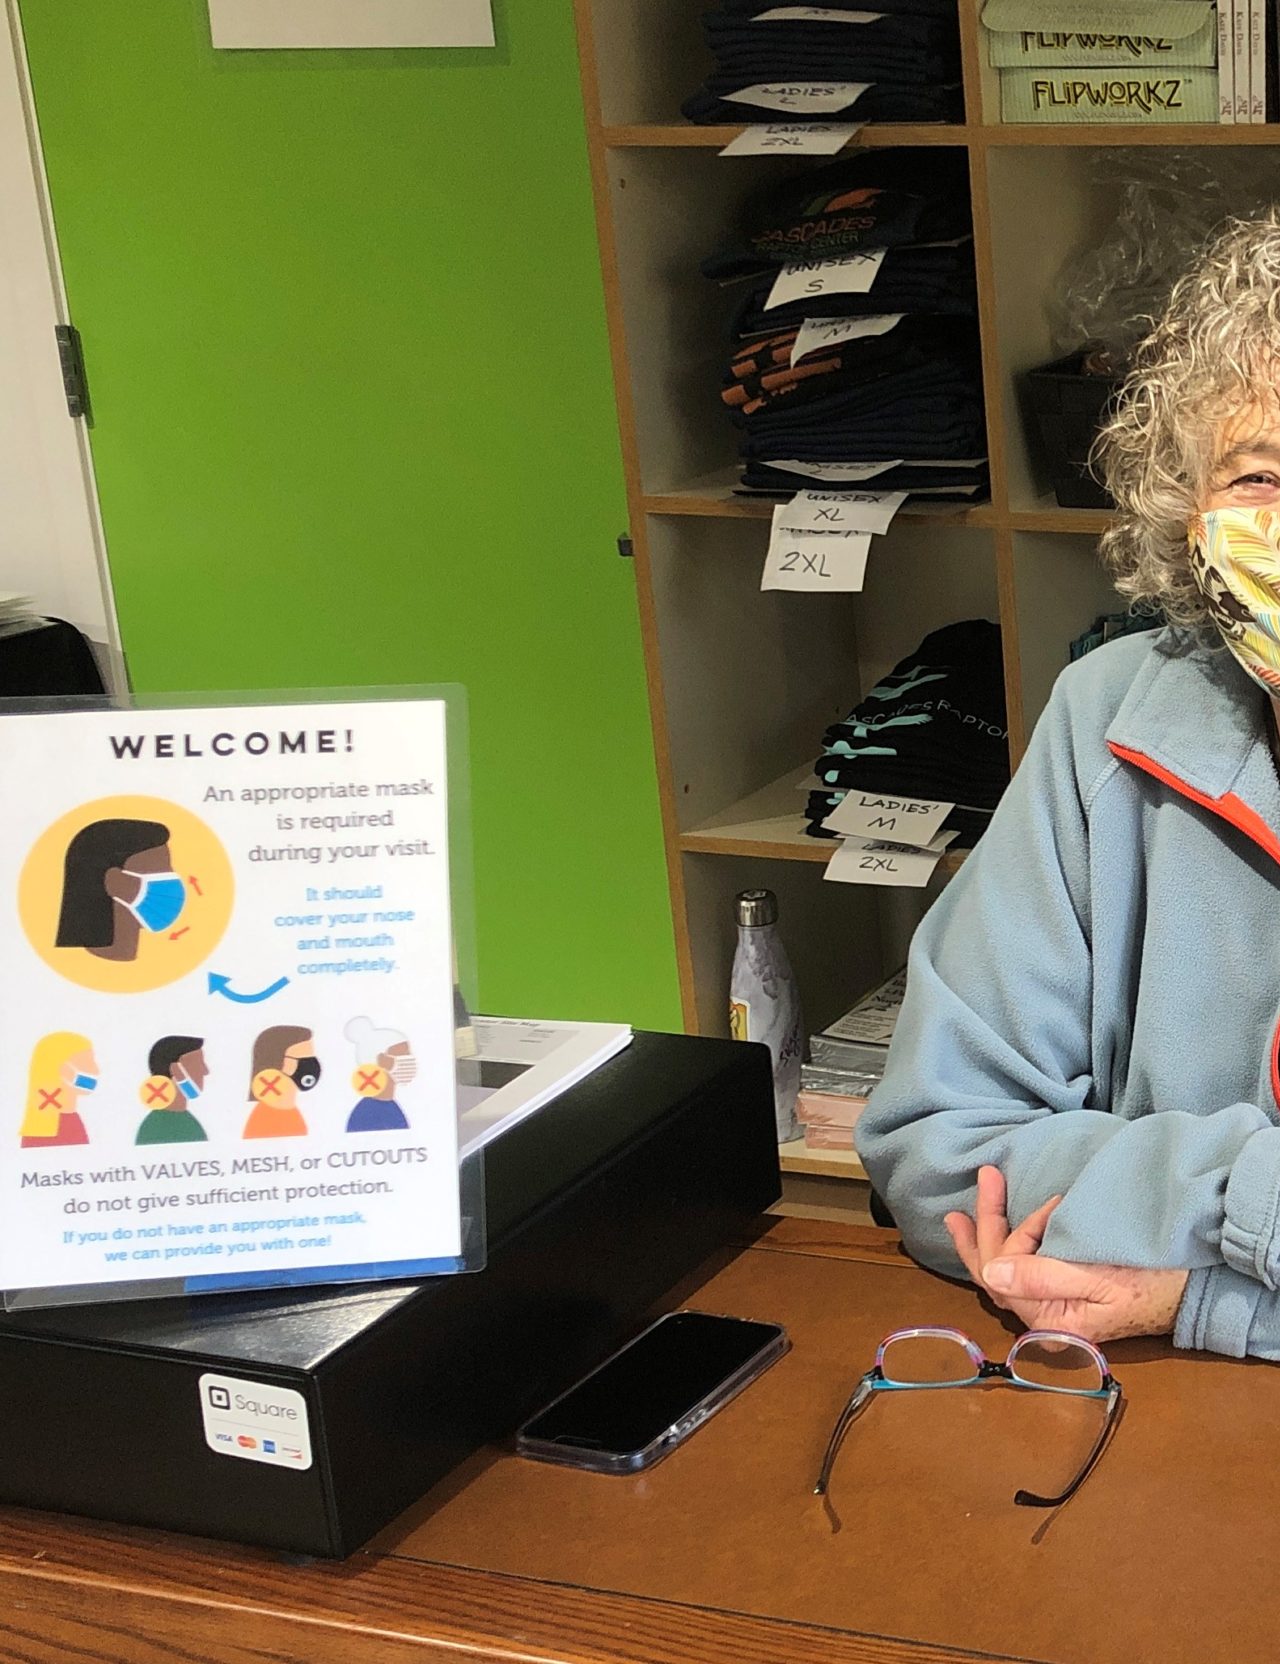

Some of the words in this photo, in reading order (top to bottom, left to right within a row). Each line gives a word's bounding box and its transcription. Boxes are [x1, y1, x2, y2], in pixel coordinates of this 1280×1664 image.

[804, 279, 825, 293] S
[813, 507, 845, 521] XL
[779, 552, 831, 578] 2XL
[111, 729, 355, 760] WELCOME!
[203, 785, 235, 803] An
[240, 781, 370, 806] appropriate
[375, 778, 434, 799] mask
[859, 796, 939, 815] LADIES'
[276, 814, 293, 831] is
[300, 810, 394, 833] required
[867, 817, 896, 831] M
[248, 845, 322, 864] during
[326, 843, 381, 864] your
[385, 840, 436, 859] visit.
[859, 857, 898, 872] 2XL
[306, 887, 321, 902] It
[323, 885, 383, 902] should
[274, 912, 322, 928] cover
[326, 910, 369, 928] your
[373, 907, 415, 923] nose
[297, 934, 331, 951] and
[335, 933, 395, 950] mouth
[20, 1168, 84, 1189] Masks
[90, 1166, 136, 1185] with
[141, 1160, 226, 1181] VALVES,
[231, 1156, 295, 1175] MESH,
[300, 1155, 321, 1171] or
[327, 1147, 429, 1169] CUTOUTS
[63, 1198, 91, 1215] do
[96, 1195, 132, 1213] not
[138, 1193, 180, 1214] give
[186, 1185, 279, 1208] sufficient
[284, 1178, 394, 1203] protection.
[63, 1230, 77, 1244] If
[77, 1229, 109, 1246] you
[112, 1227, 133, 1241] do
[137, 1225, 164, 1239] not
[167, 1222, 205, 1236] have
[208, 1222, 229, 1234] an
[232, 1215, 320, 1235] appropriate
[105, 1250, 130, 1263] we
[133, 1246, 162, 1260] can
[165, 1242, 224, 1260] provide
[227, 1240, 259, 1256] you
[261, 1236, 295, 1250] with
[298, 1233, 332, 1248] one!
[235, 1394, 298, 1420] Square
